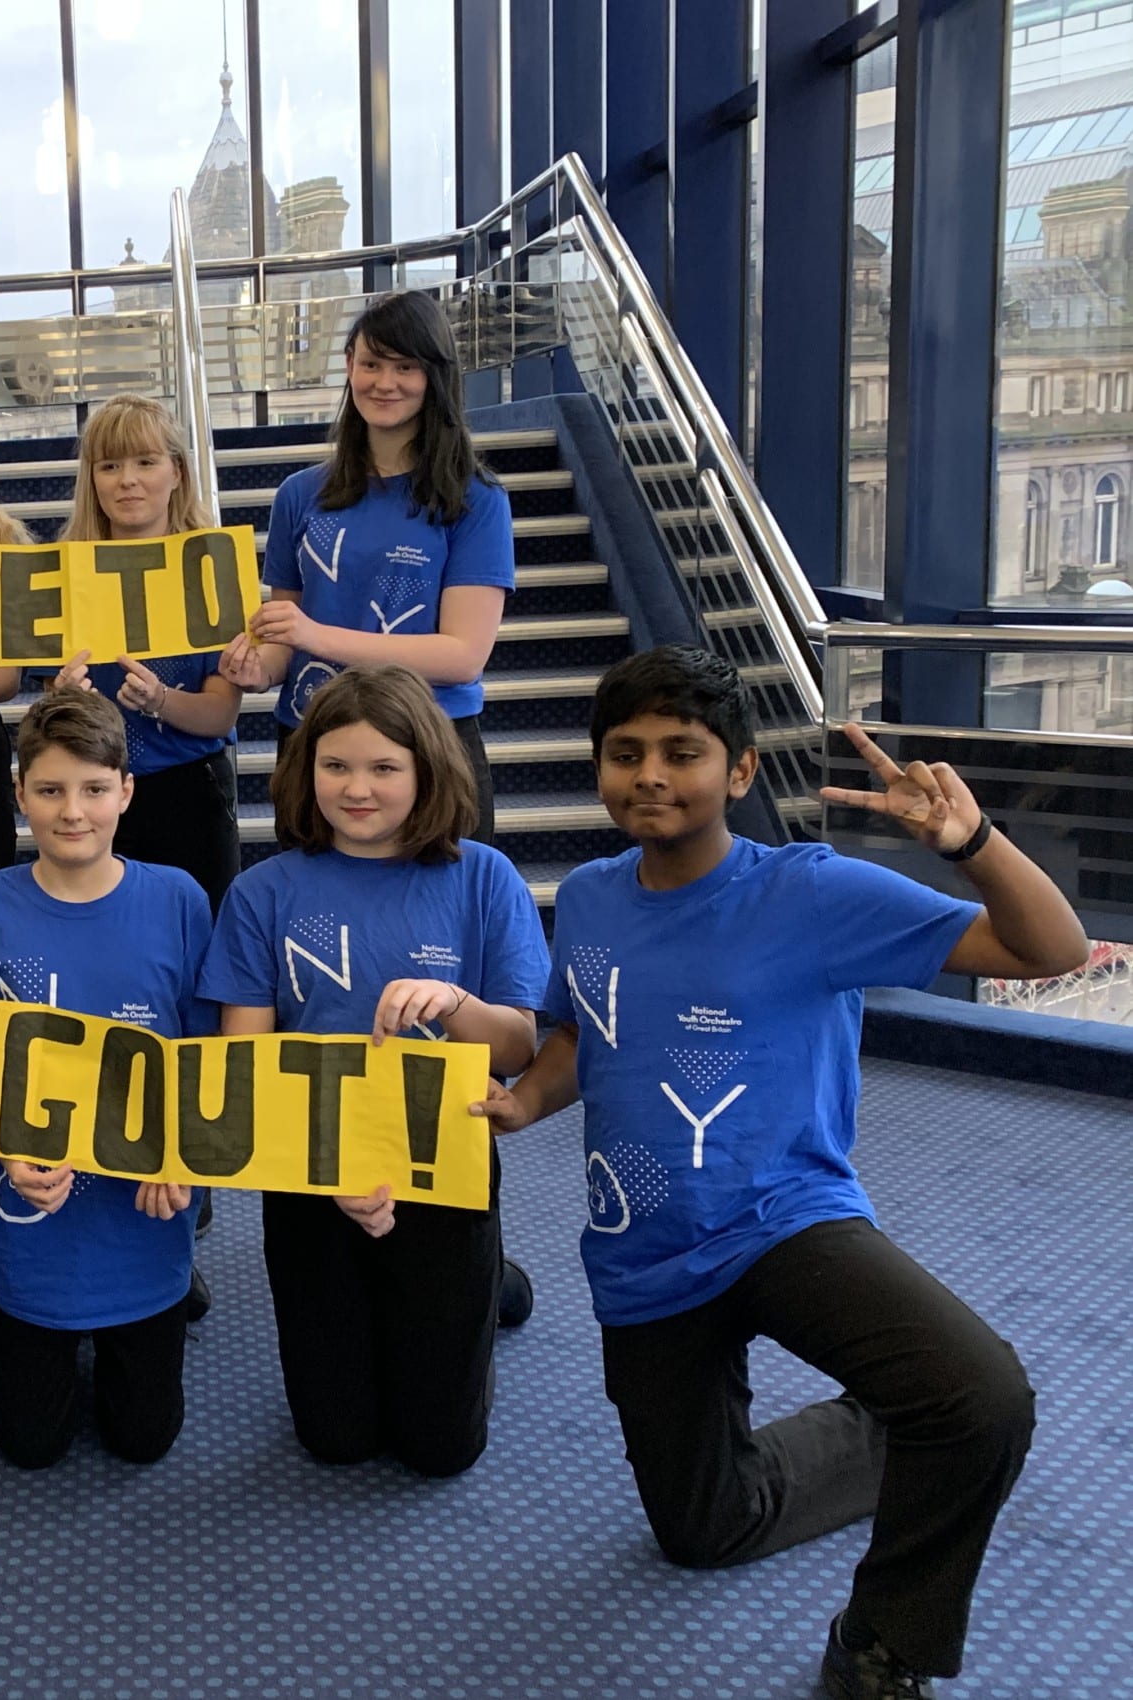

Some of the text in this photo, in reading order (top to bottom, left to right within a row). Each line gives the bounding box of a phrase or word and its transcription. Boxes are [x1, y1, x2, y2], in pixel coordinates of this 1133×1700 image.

[95, 532, 246, 653] TO
[285, 925, 351, 1002] N
[677, 1014, 743, 1026] Youth Orchestra
[691, 1005, 727, 1017] National
[660, 1081, 747, 1168] Y
